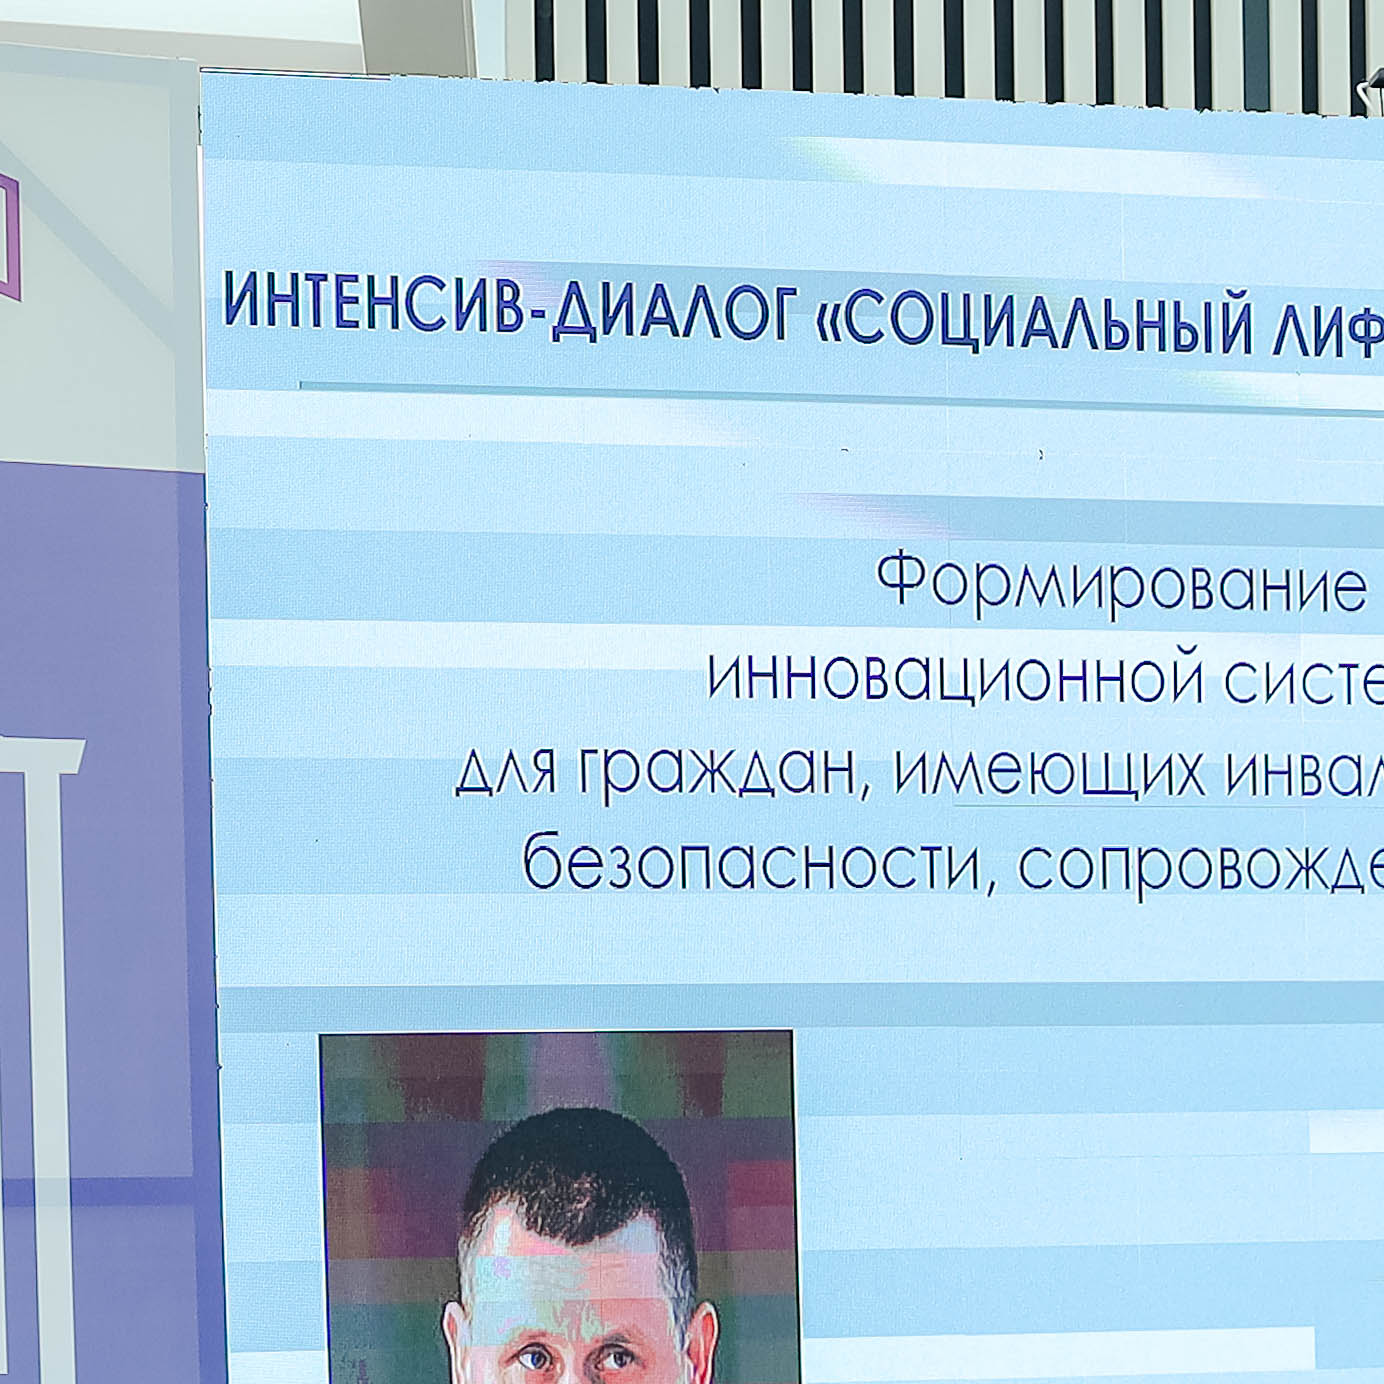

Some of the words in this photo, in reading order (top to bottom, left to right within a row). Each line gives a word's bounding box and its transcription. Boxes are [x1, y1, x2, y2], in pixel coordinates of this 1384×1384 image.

[224, 270, 798, 344] ИНТЕНСИВ-ДИАЛОГ
[816, 288, 1252, 355] «СОЦИАЛЬНЫЙ
[877, 549, 1367, 623] Формирование
[708, 644, 1203, 708] инновационной
[455, 748, 555, 798] для
[580, 748, 870, 808] граждан,
[895, 750, 1206, 802] имеющих
[523, 830, 996, 898] безопасности,
